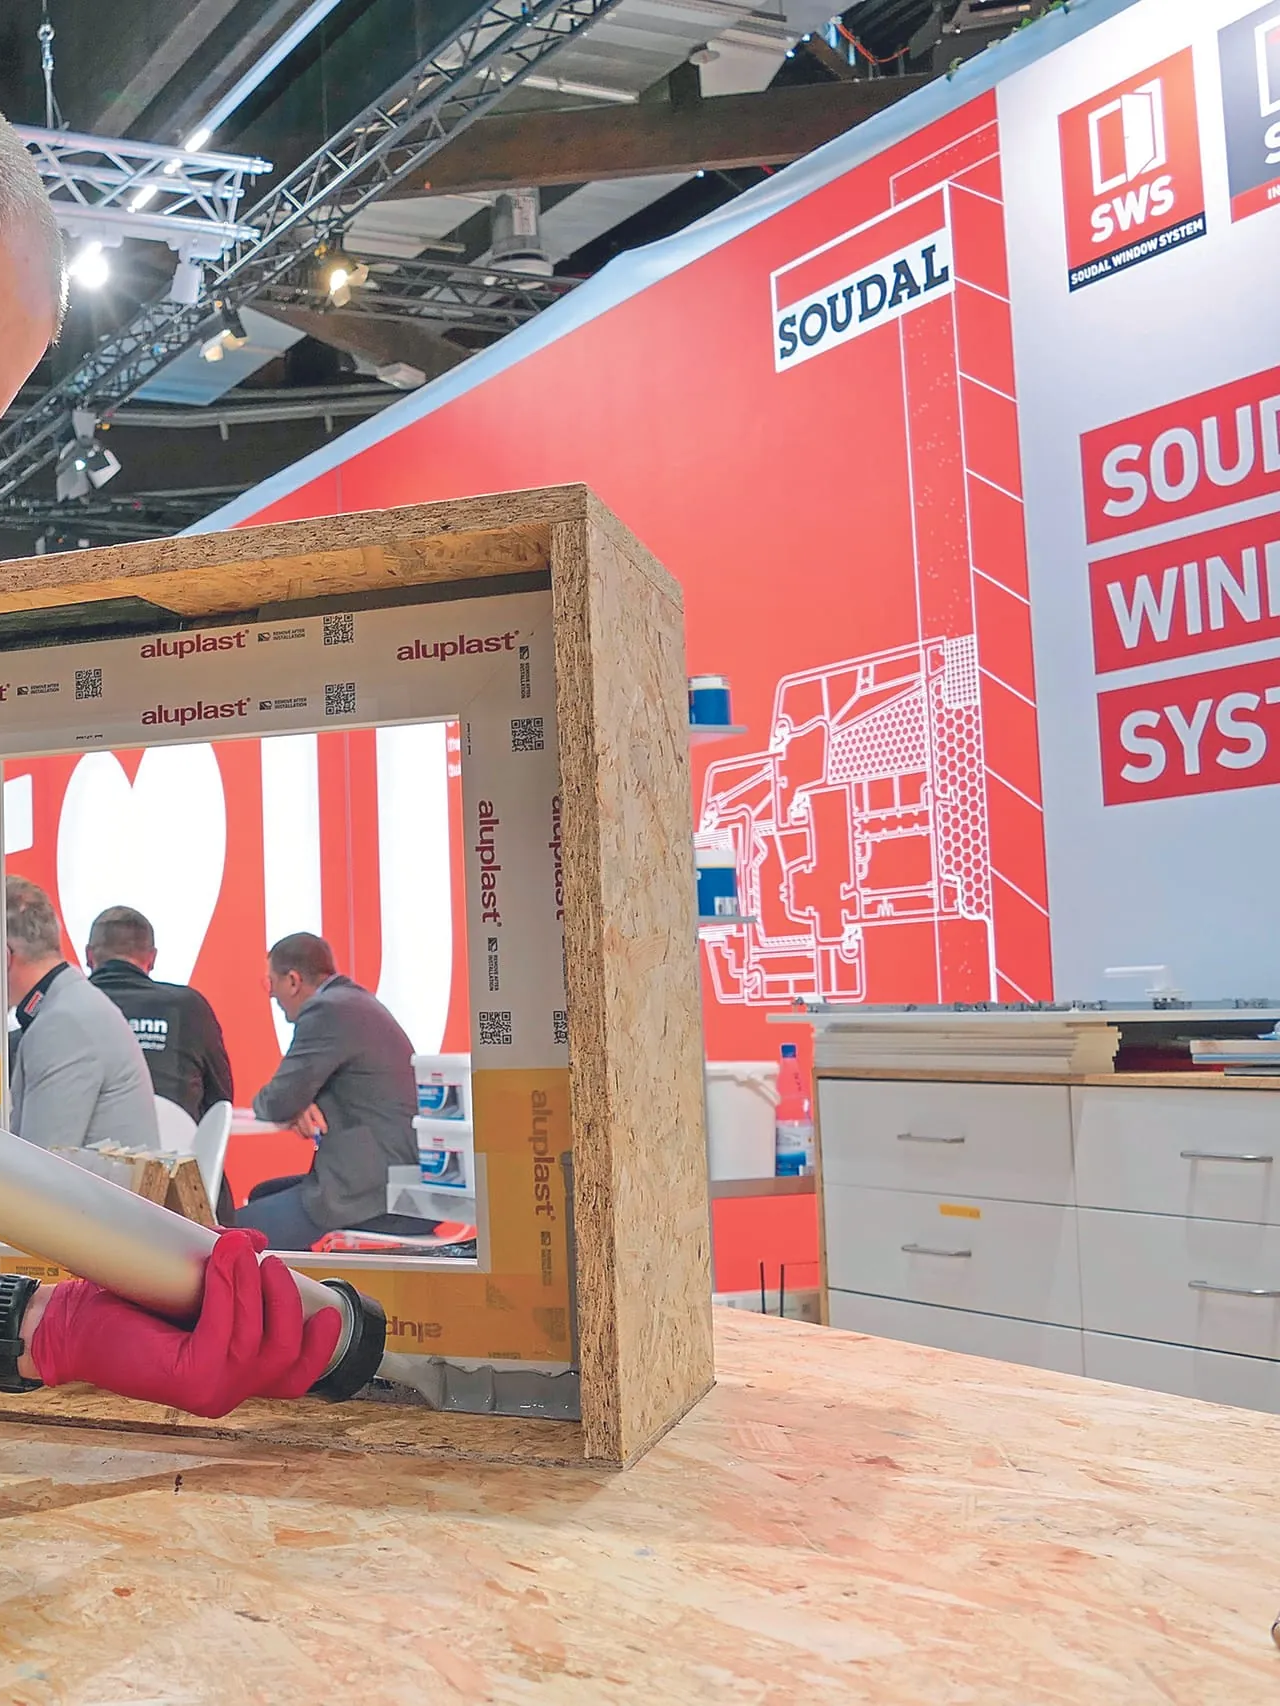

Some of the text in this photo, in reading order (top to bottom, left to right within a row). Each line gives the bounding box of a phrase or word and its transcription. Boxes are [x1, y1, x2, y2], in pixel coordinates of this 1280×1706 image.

[1071, 218, 1204, 285] SOUDAL WINDOW SYSTEM
[1091, 176, 1174, 242] SWS
[778, 244, 950, 359] SOUDAL
[475, 800, 502, 924] aluplast
